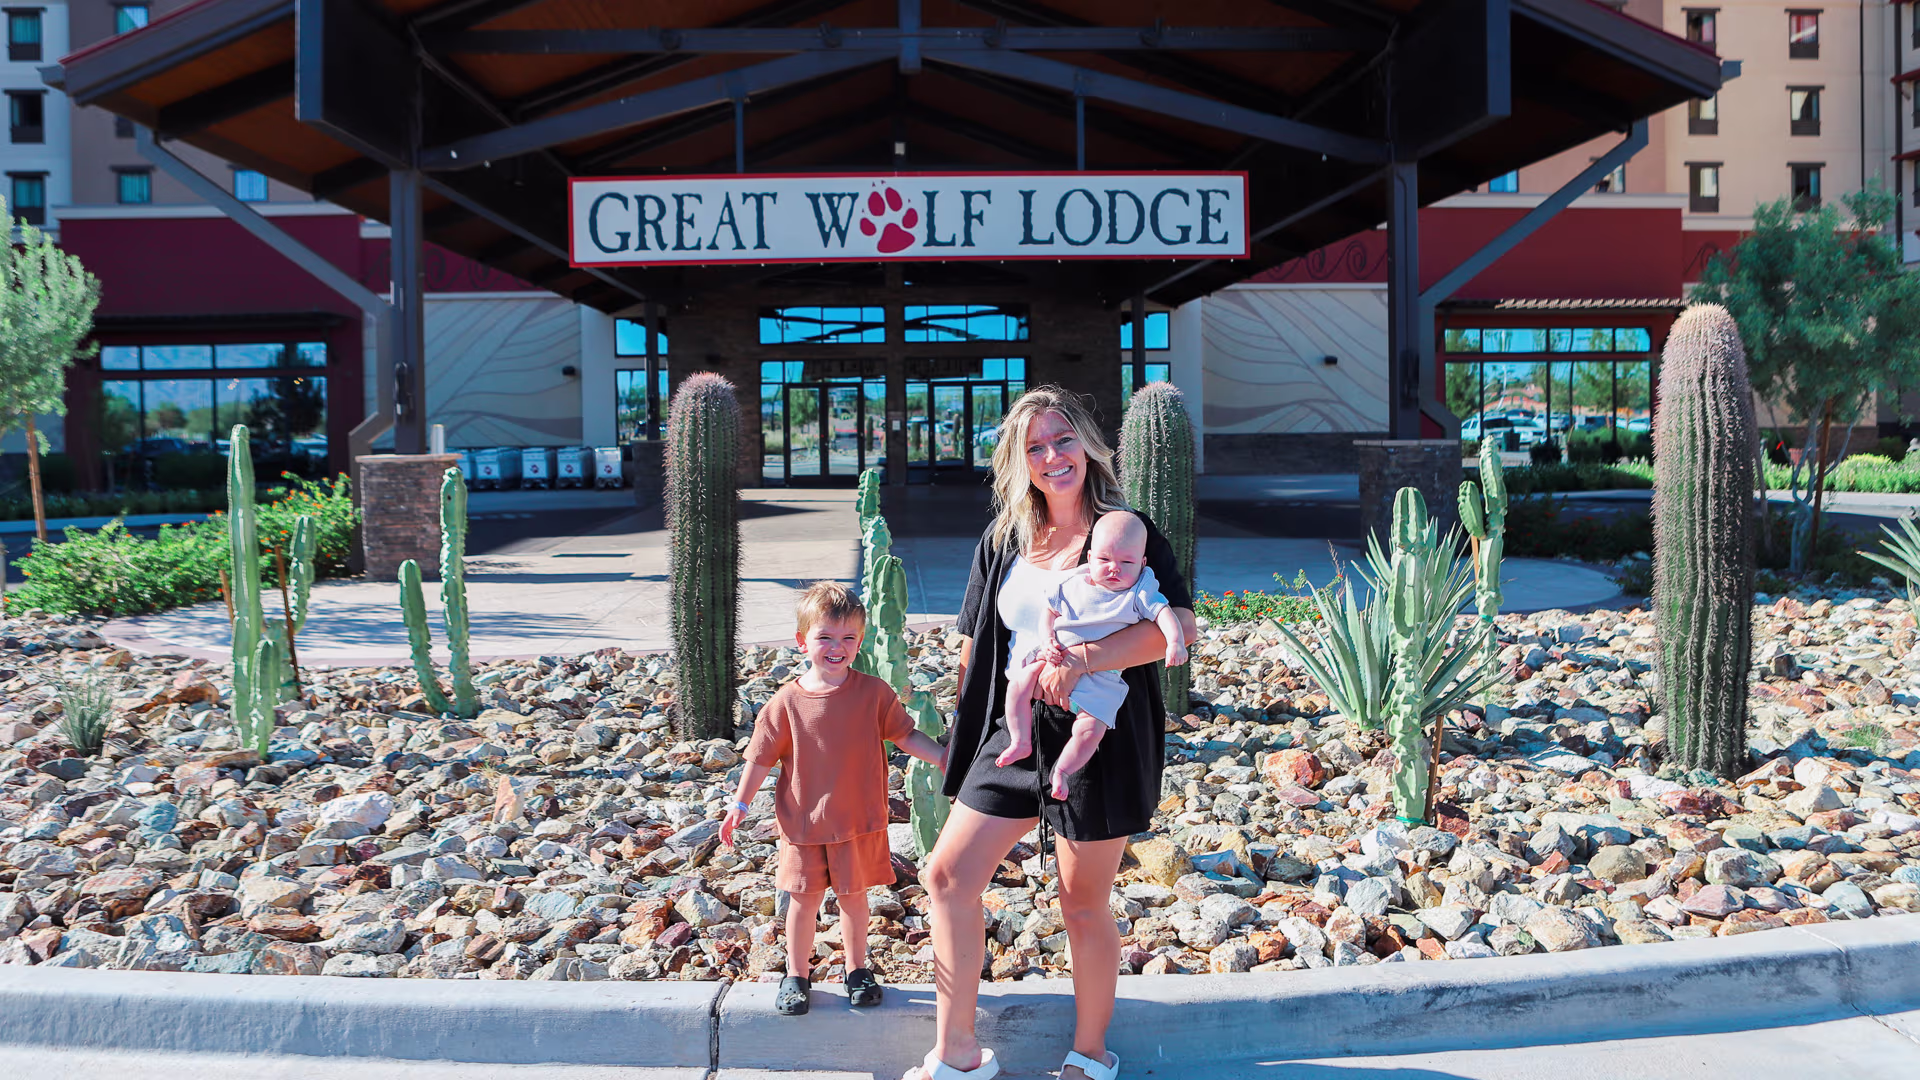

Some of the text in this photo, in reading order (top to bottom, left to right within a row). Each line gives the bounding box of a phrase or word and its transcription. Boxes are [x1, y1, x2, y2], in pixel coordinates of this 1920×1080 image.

[588, 187, 1231, 254] GREAT WLF LODGE
